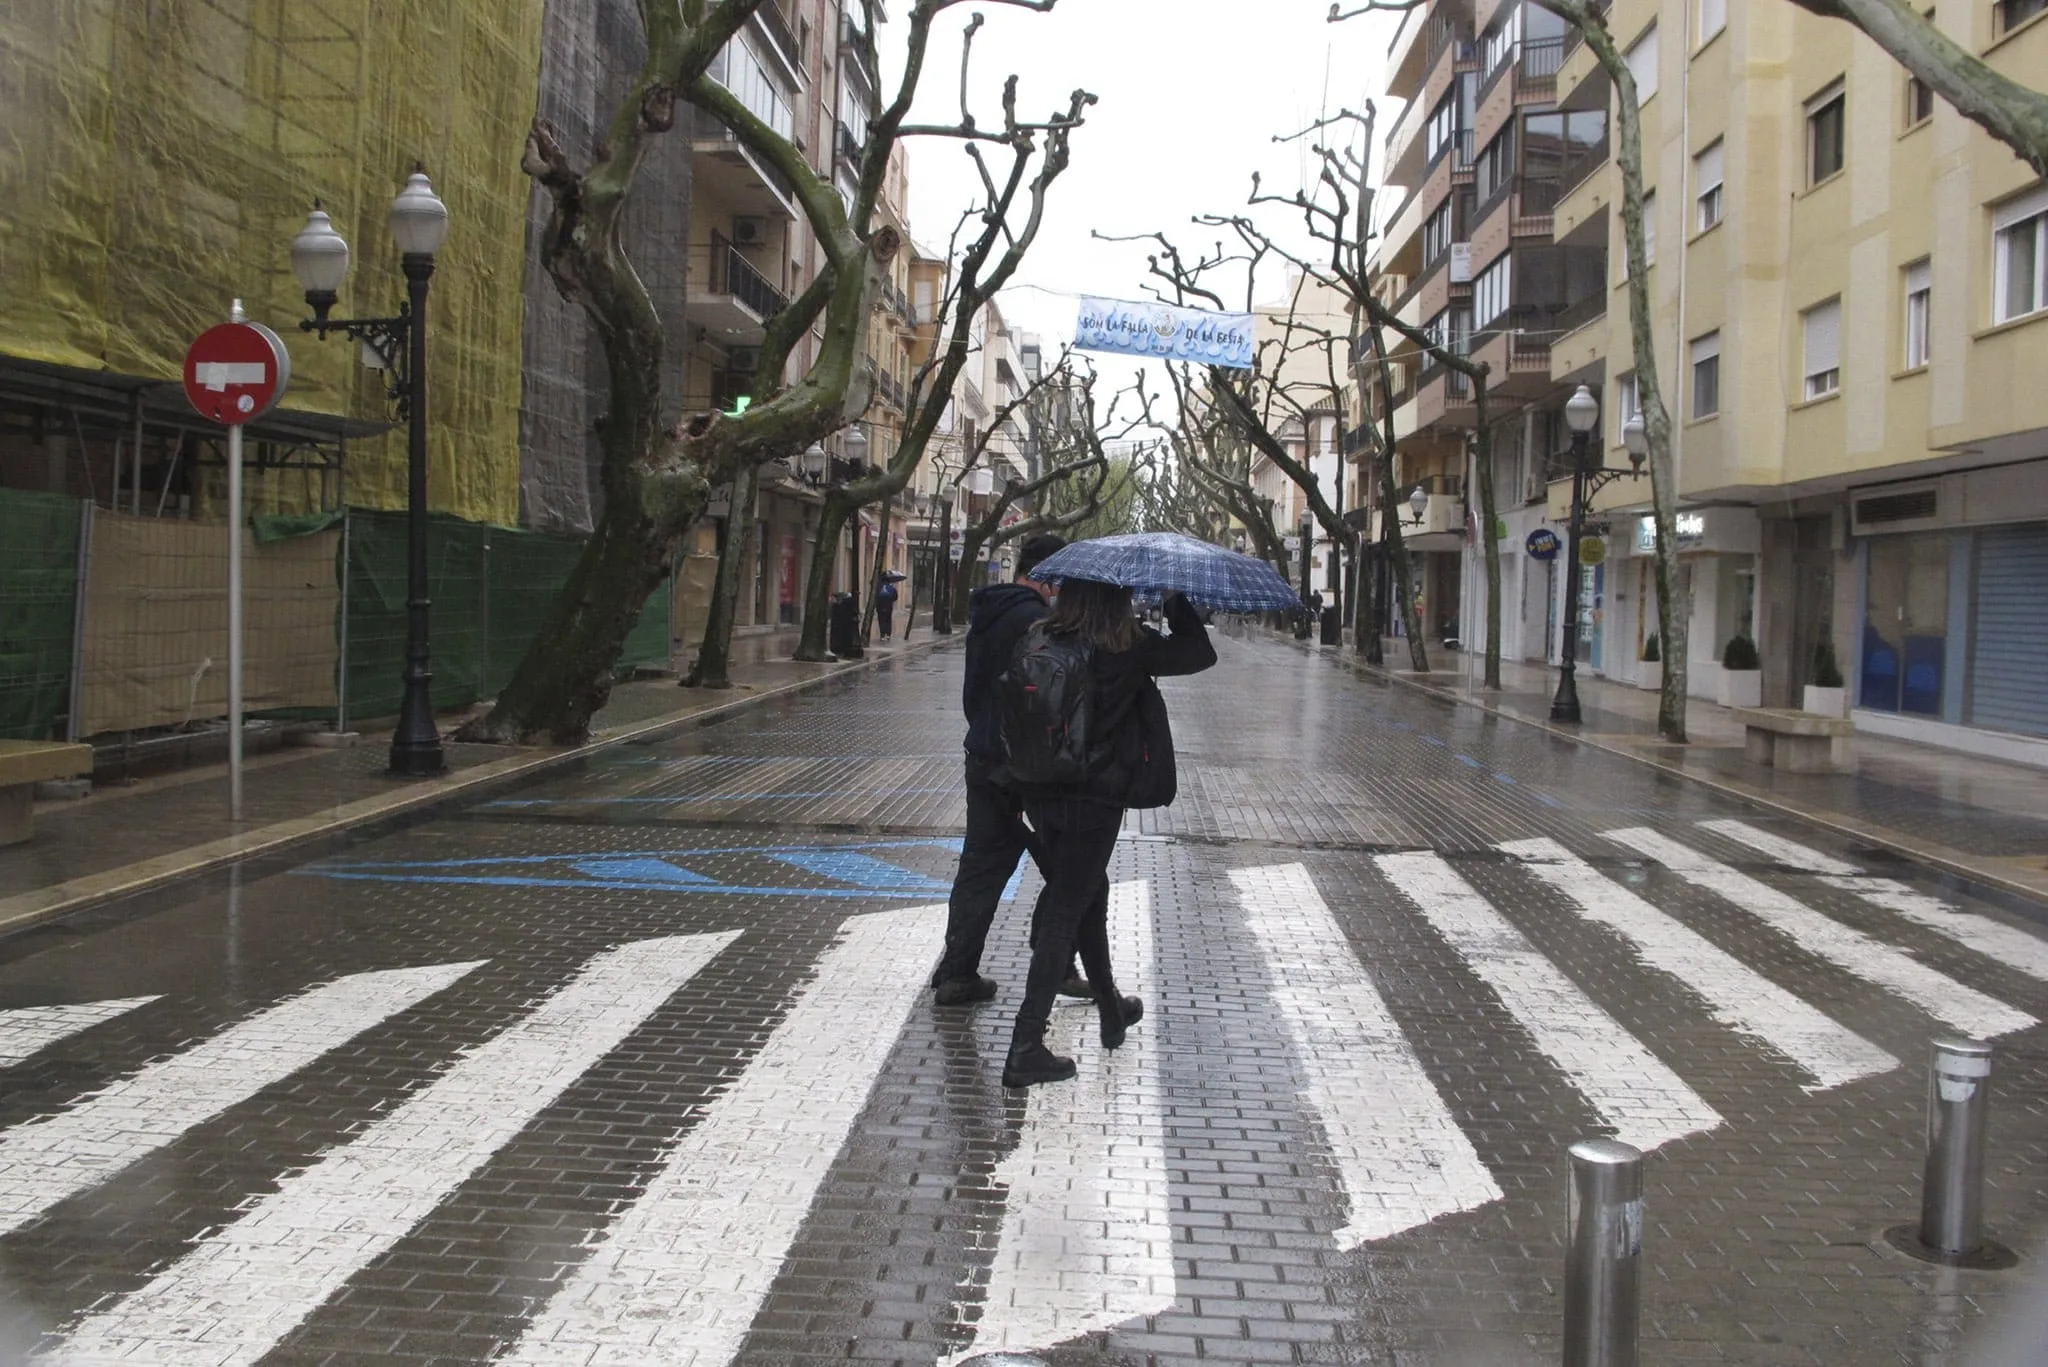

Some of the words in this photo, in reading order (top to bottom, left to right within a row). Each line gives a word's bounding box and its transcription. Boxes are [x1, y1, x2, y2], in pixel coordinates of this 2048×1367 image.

[1082, 316, 1103, 329] SOM
[1106, 317, 1119, 331] LA
[1121, 319, 1148, 333] FALLA
[1186, 328, 1199, 341] DE
[1202, 329, 1214, 341] LA
